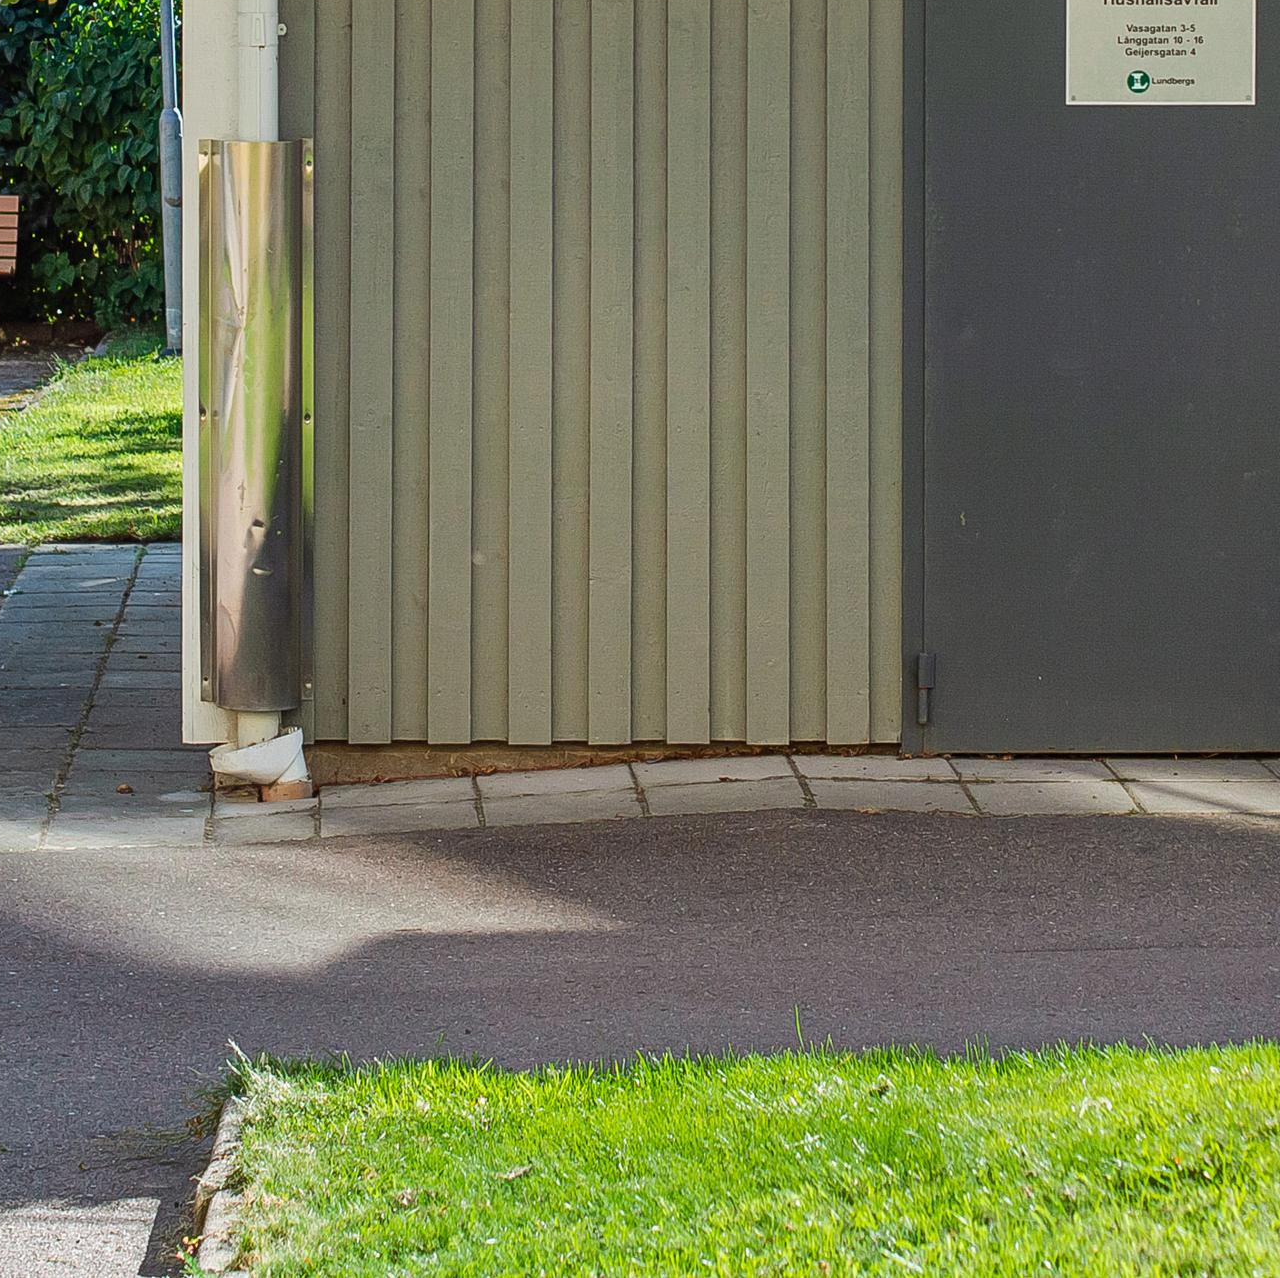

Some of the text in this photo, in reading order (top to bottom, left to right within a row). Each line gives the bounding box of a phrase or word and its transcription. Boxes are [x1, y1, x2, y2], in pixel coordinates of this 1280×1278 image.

[1126, 23, 1196, 35] Vasagatan 3-5
[1117, 35, 1169, 47] Långgatan
[1173, 36, 1183, 45] 10
[1194, 36, 1204, 45] 16
[1125, 47, 1197, 59] Geijersgatan 4
[1151, 77, 1196, 87] Lundbergs
